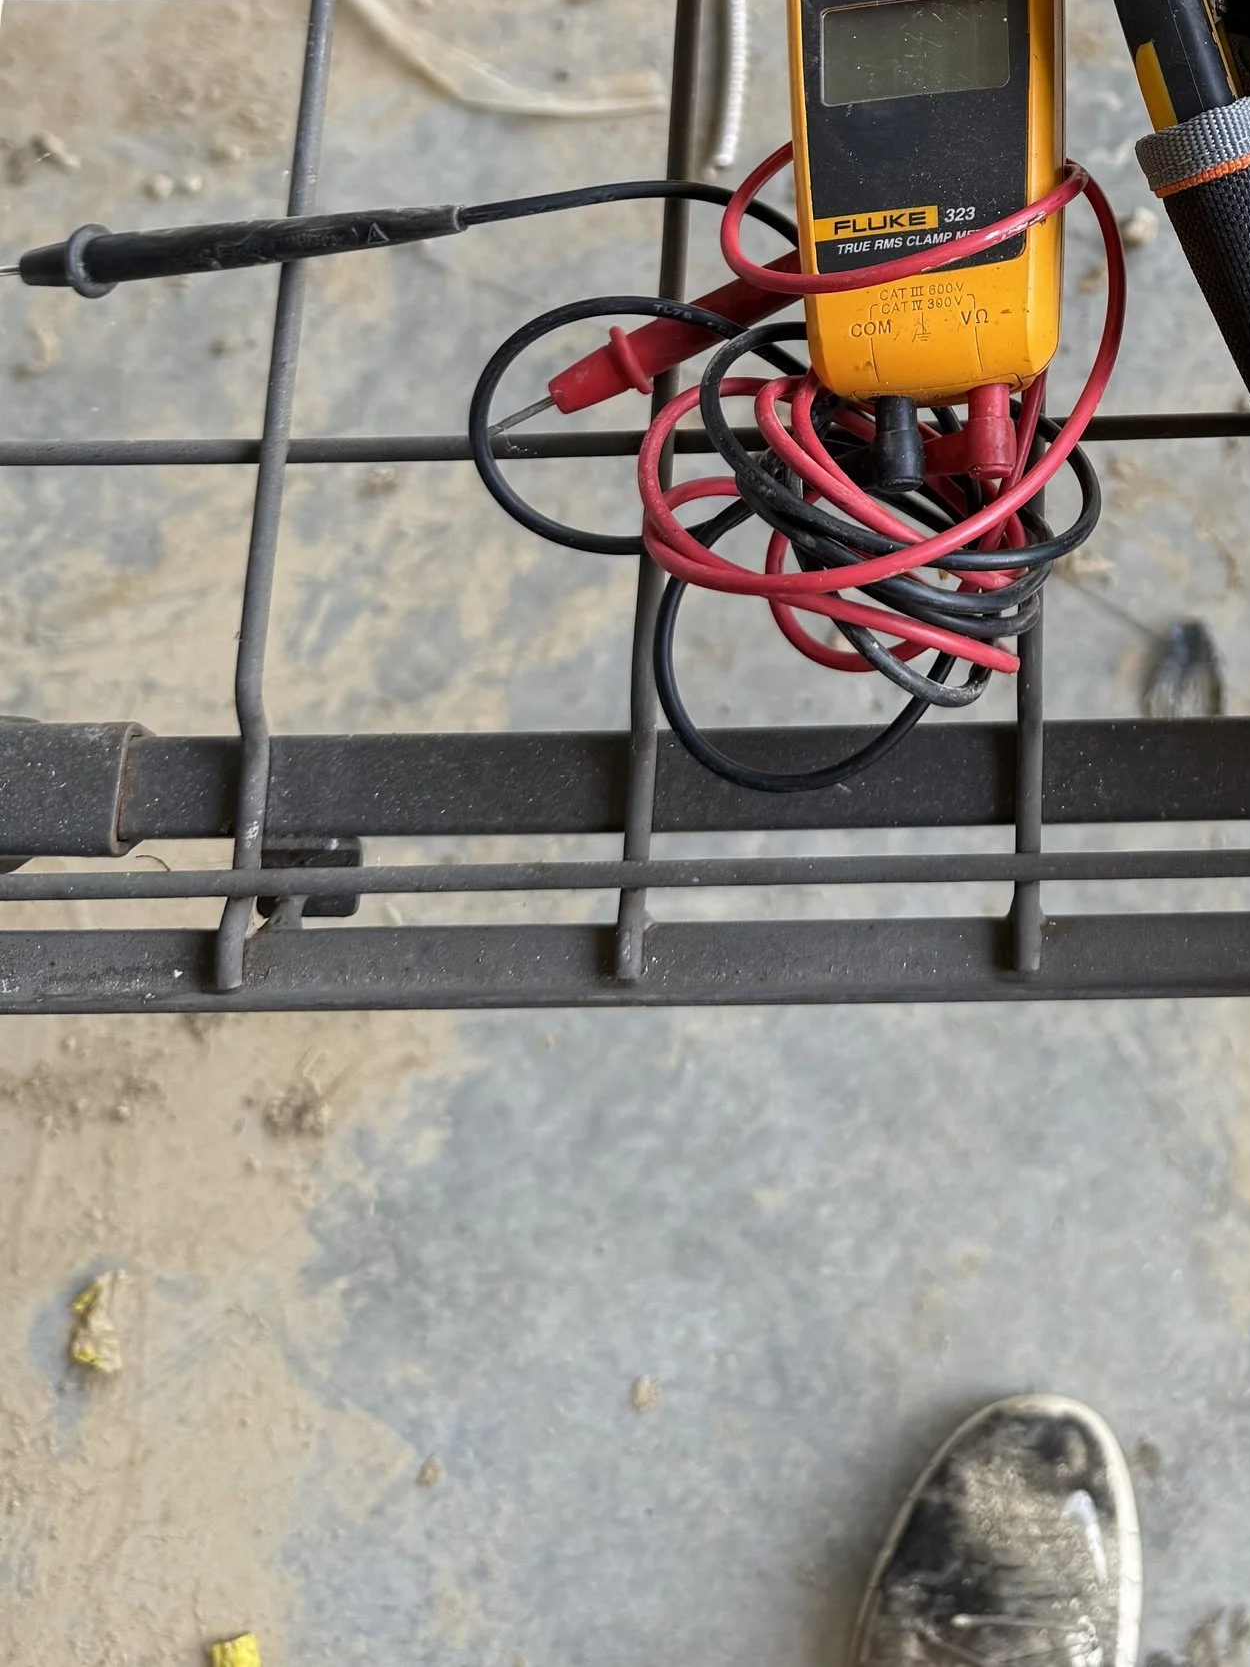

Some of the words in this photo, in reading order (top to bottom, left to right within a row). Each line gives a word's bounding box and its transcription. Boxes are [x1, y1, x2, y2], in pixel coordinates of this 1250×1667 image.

[834, 211, 927, 235] FLUKE
[944, 206, 976, 223] 323
[837, 239, 871, 255] TRUE
[874, 234, 903, 249] RMS
[906, 231, 952, 247] CLAMP
[880, 287, 907, 301] CAT
[910, 286, 924, 297] III
[881, 301, 908, 314] CAT
[912, 300, 923, 311] IV
[851, 320, 891, 337] COM
